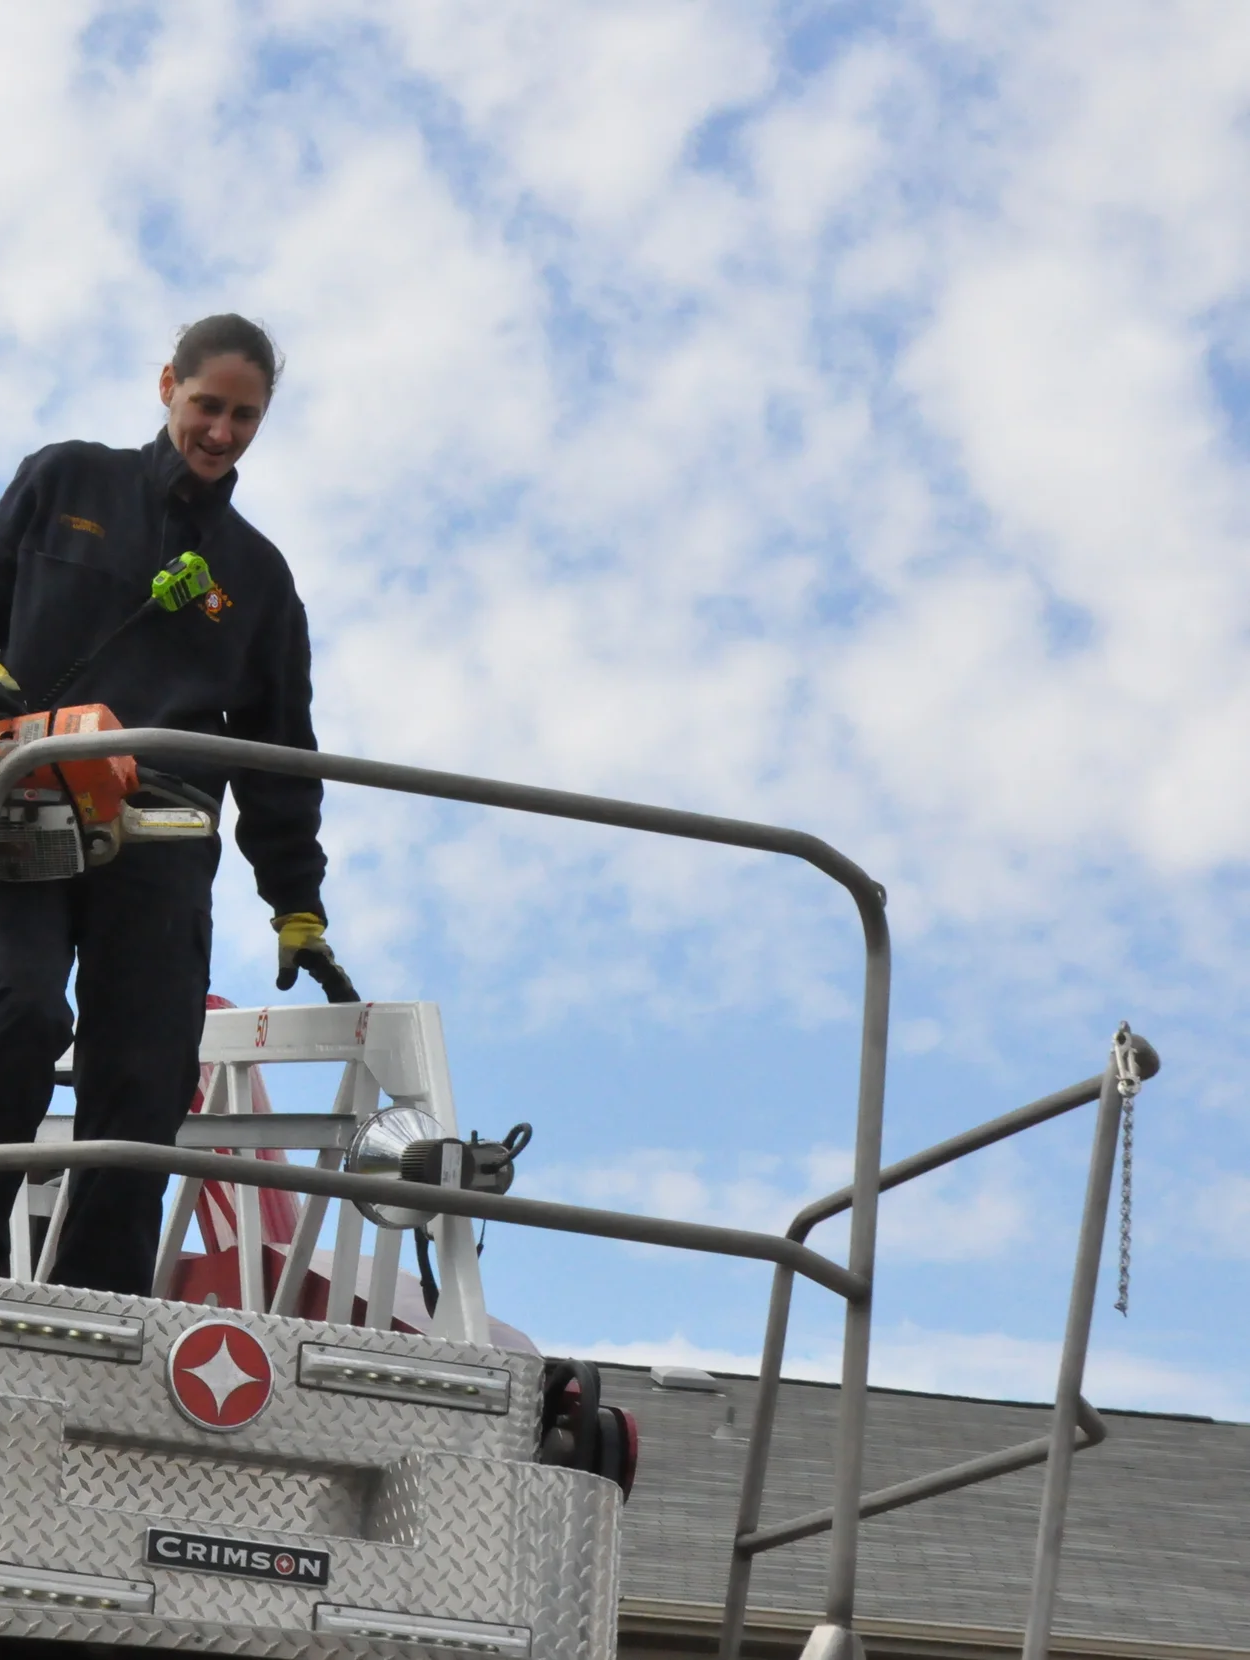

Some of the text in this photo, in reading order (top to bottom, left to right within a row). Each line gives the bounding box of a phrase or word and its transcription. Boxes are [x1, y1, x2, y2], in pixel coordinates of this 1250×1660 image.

[255, 1014, 268, 1047] 50
[355, 1011, 369, 1045] 45
[155, 1536, 322, 1578] CRIMSON
